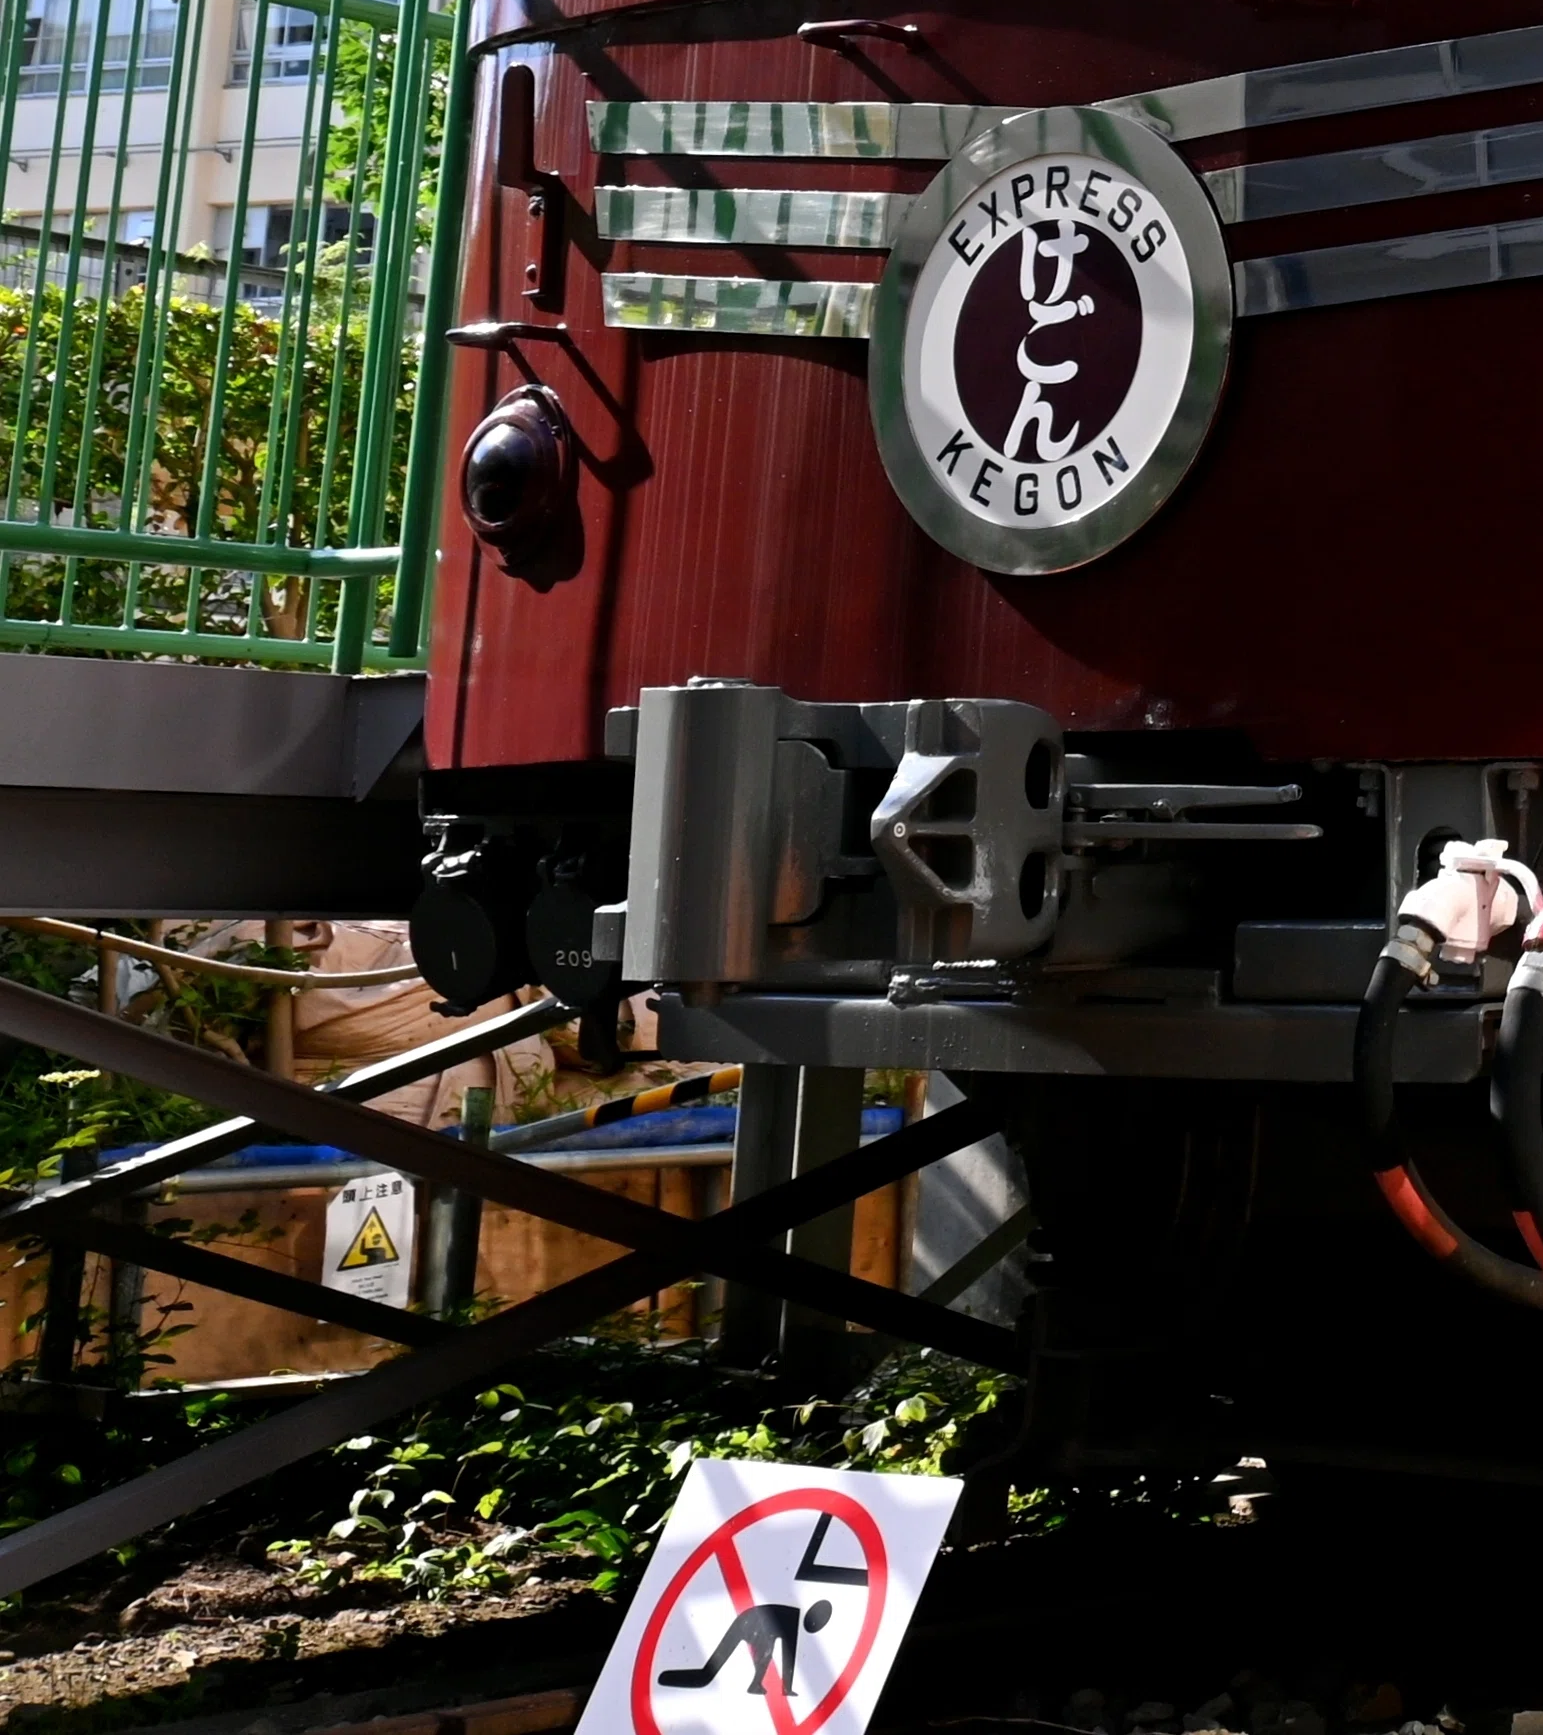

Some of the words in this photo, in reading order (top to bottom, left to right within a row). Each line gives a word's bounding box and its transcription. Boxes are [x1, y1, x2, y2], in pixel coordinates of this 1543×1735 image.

[948, 166, 1167, 266] EXPRESS
[1003, 220, 1095, 462] けごん
[937, 428, 1130, 517] KEGON
[554, 949, 593, 969] 209
[342, 1179, 404, 1204] 頭上注意
